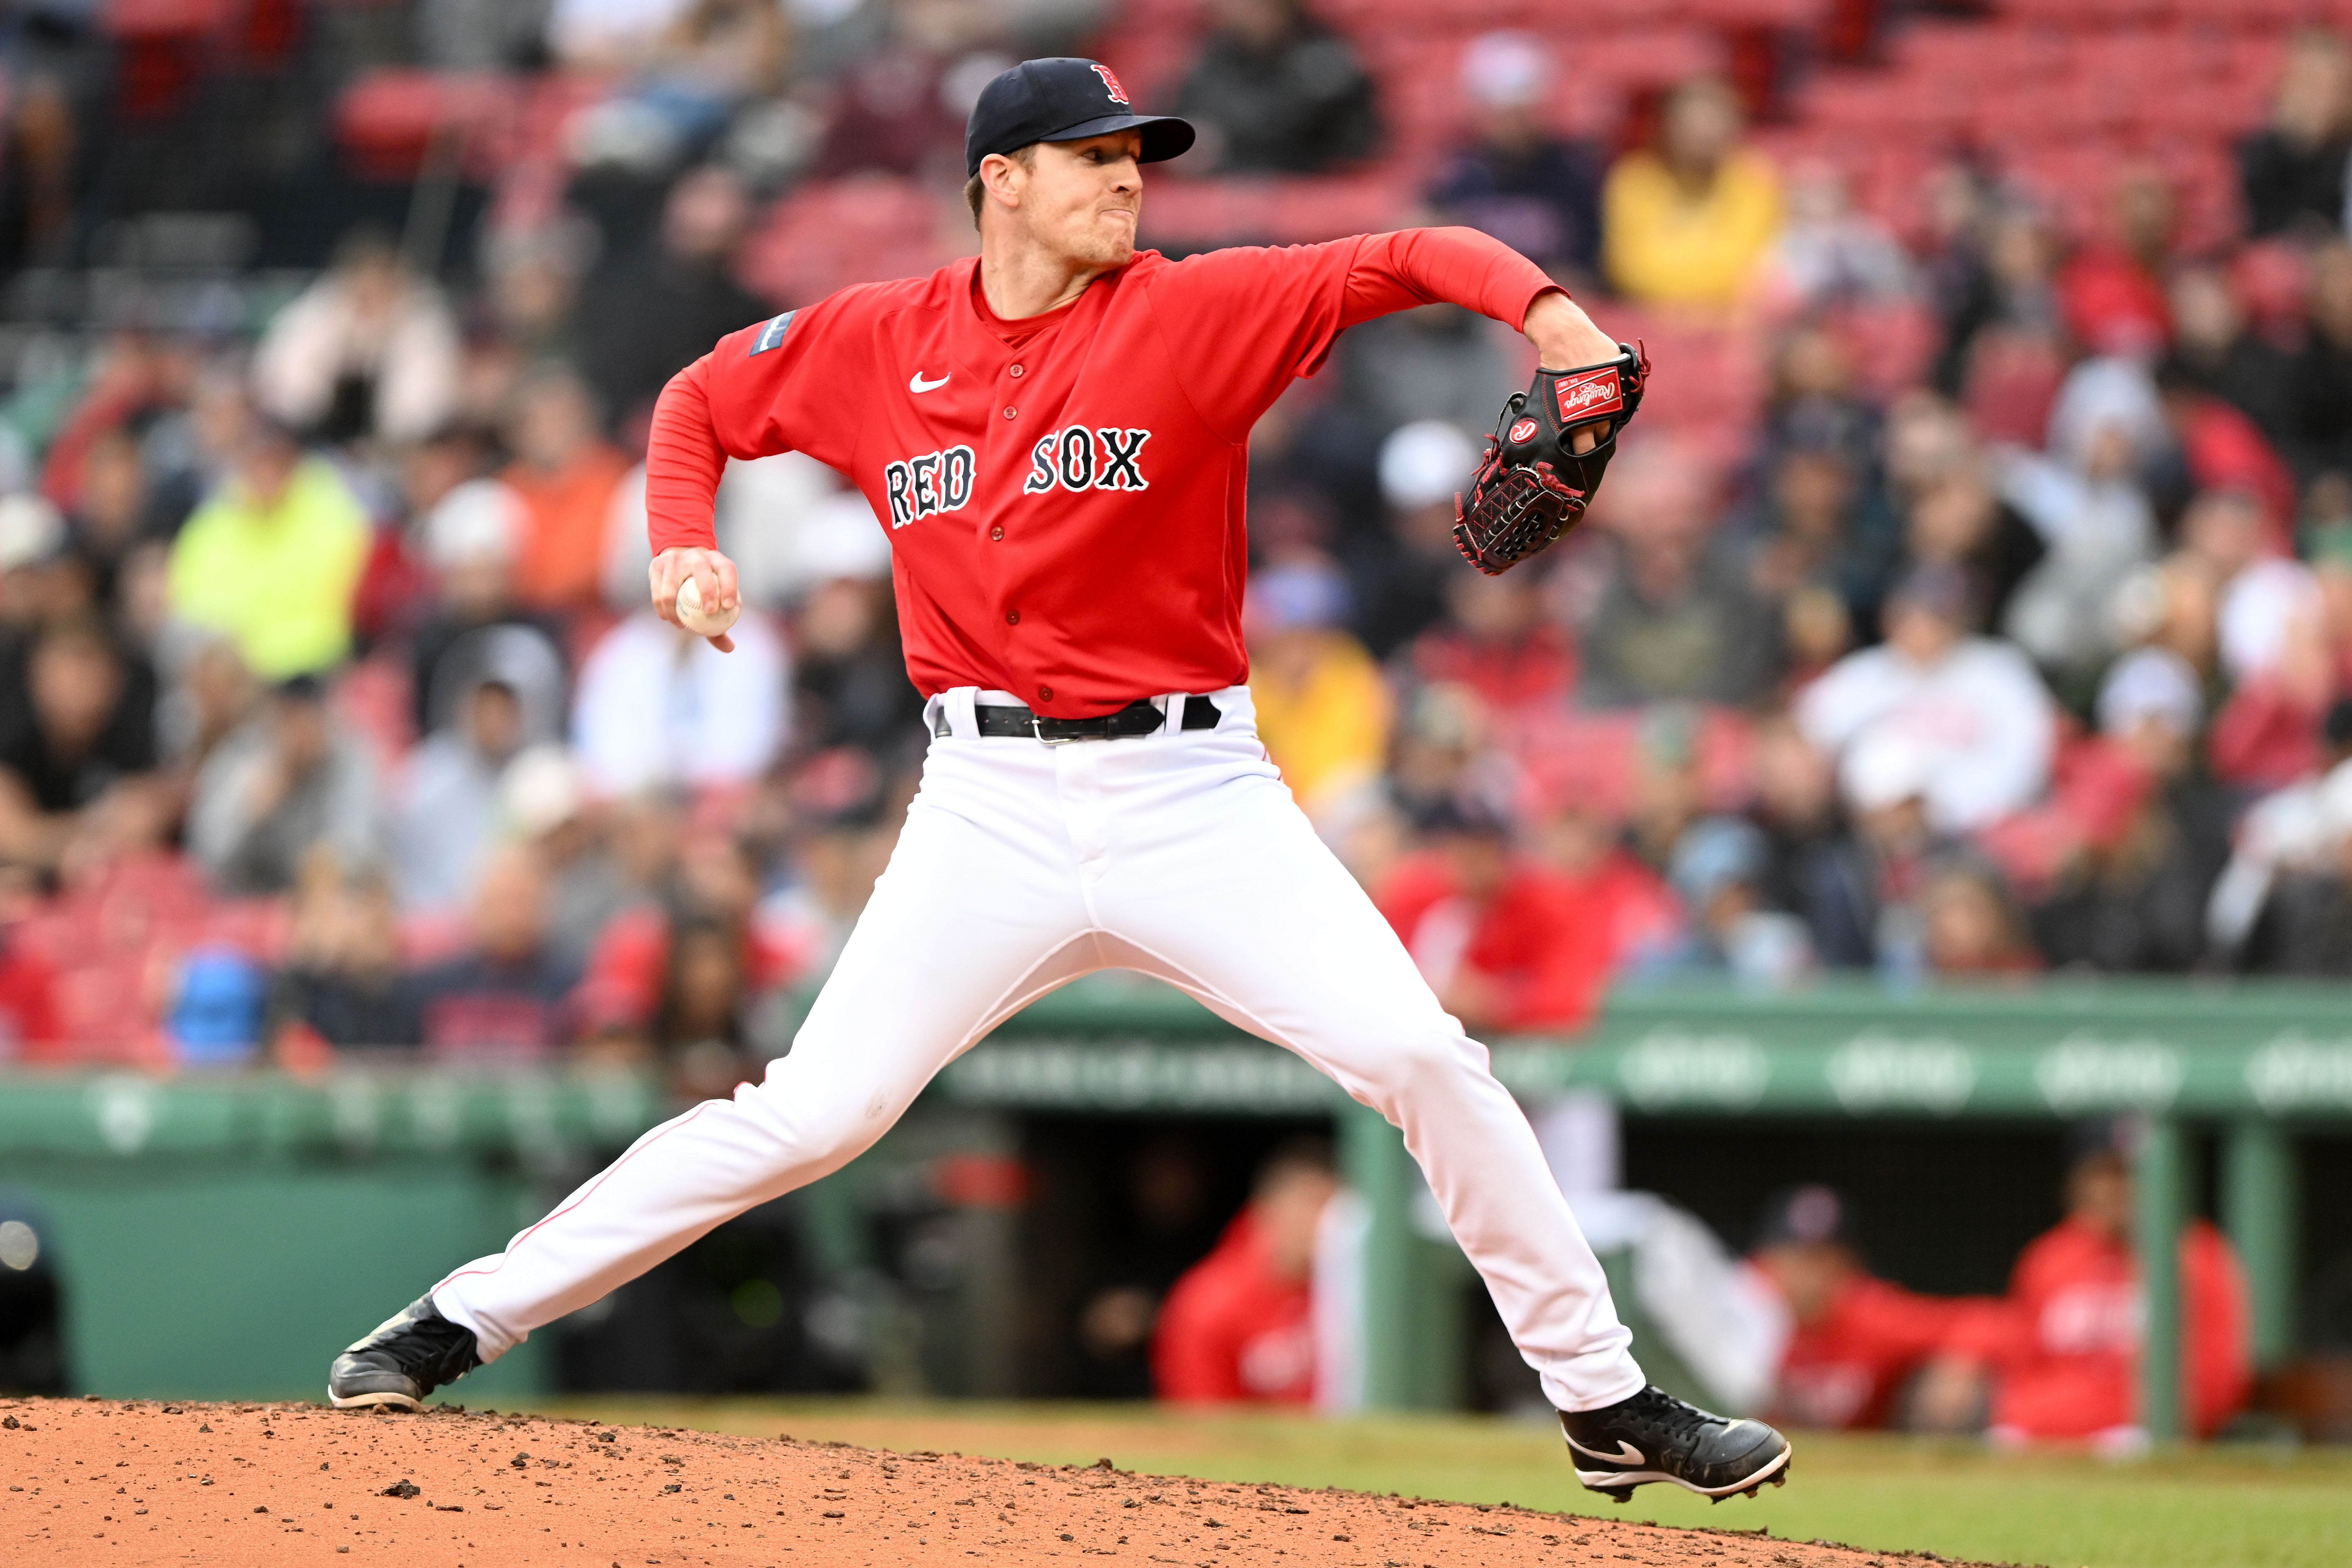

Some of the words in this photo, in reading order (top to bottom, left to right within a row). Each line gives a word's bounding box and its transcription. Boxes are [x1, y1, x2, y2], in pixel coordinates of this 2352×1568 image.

[1090, 64, 1129, 105] B
[1564, 382, 1615, 408] Rawlings
[1514, 422, 1536, 441] R
[885, 444, 977, 530] RED
[1023, 424, 1152, 495] SOX
